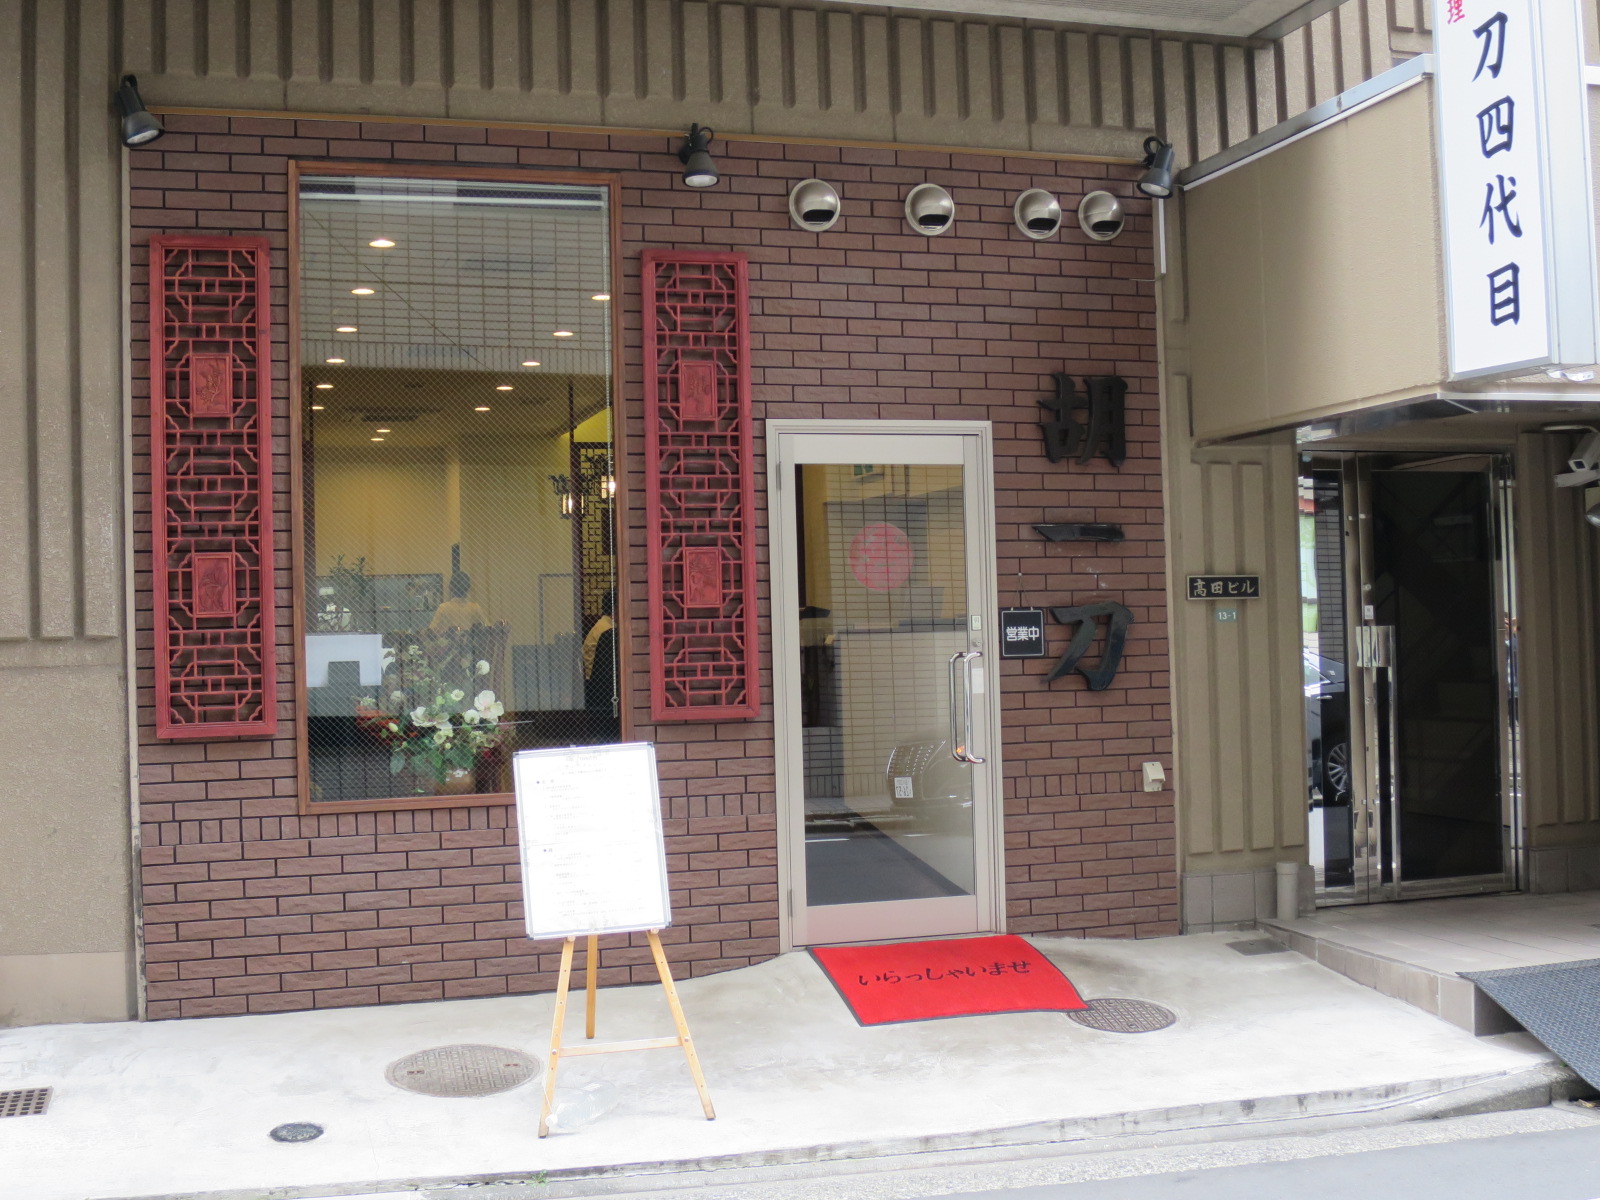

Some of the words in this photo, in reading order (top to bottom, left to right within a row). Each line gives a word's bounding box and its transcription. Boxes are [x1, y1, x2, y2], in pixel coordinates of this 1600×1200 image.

[1472, 11, 1523, 327] 刀四代目
[1032, 371, 1135, 691] 胡一刀
[1218, 611, 1236, 620] 13-1
[1006, 626, 1040, 642] 営業中
[858, 960, 1032, 986] いらっしゃいませ
